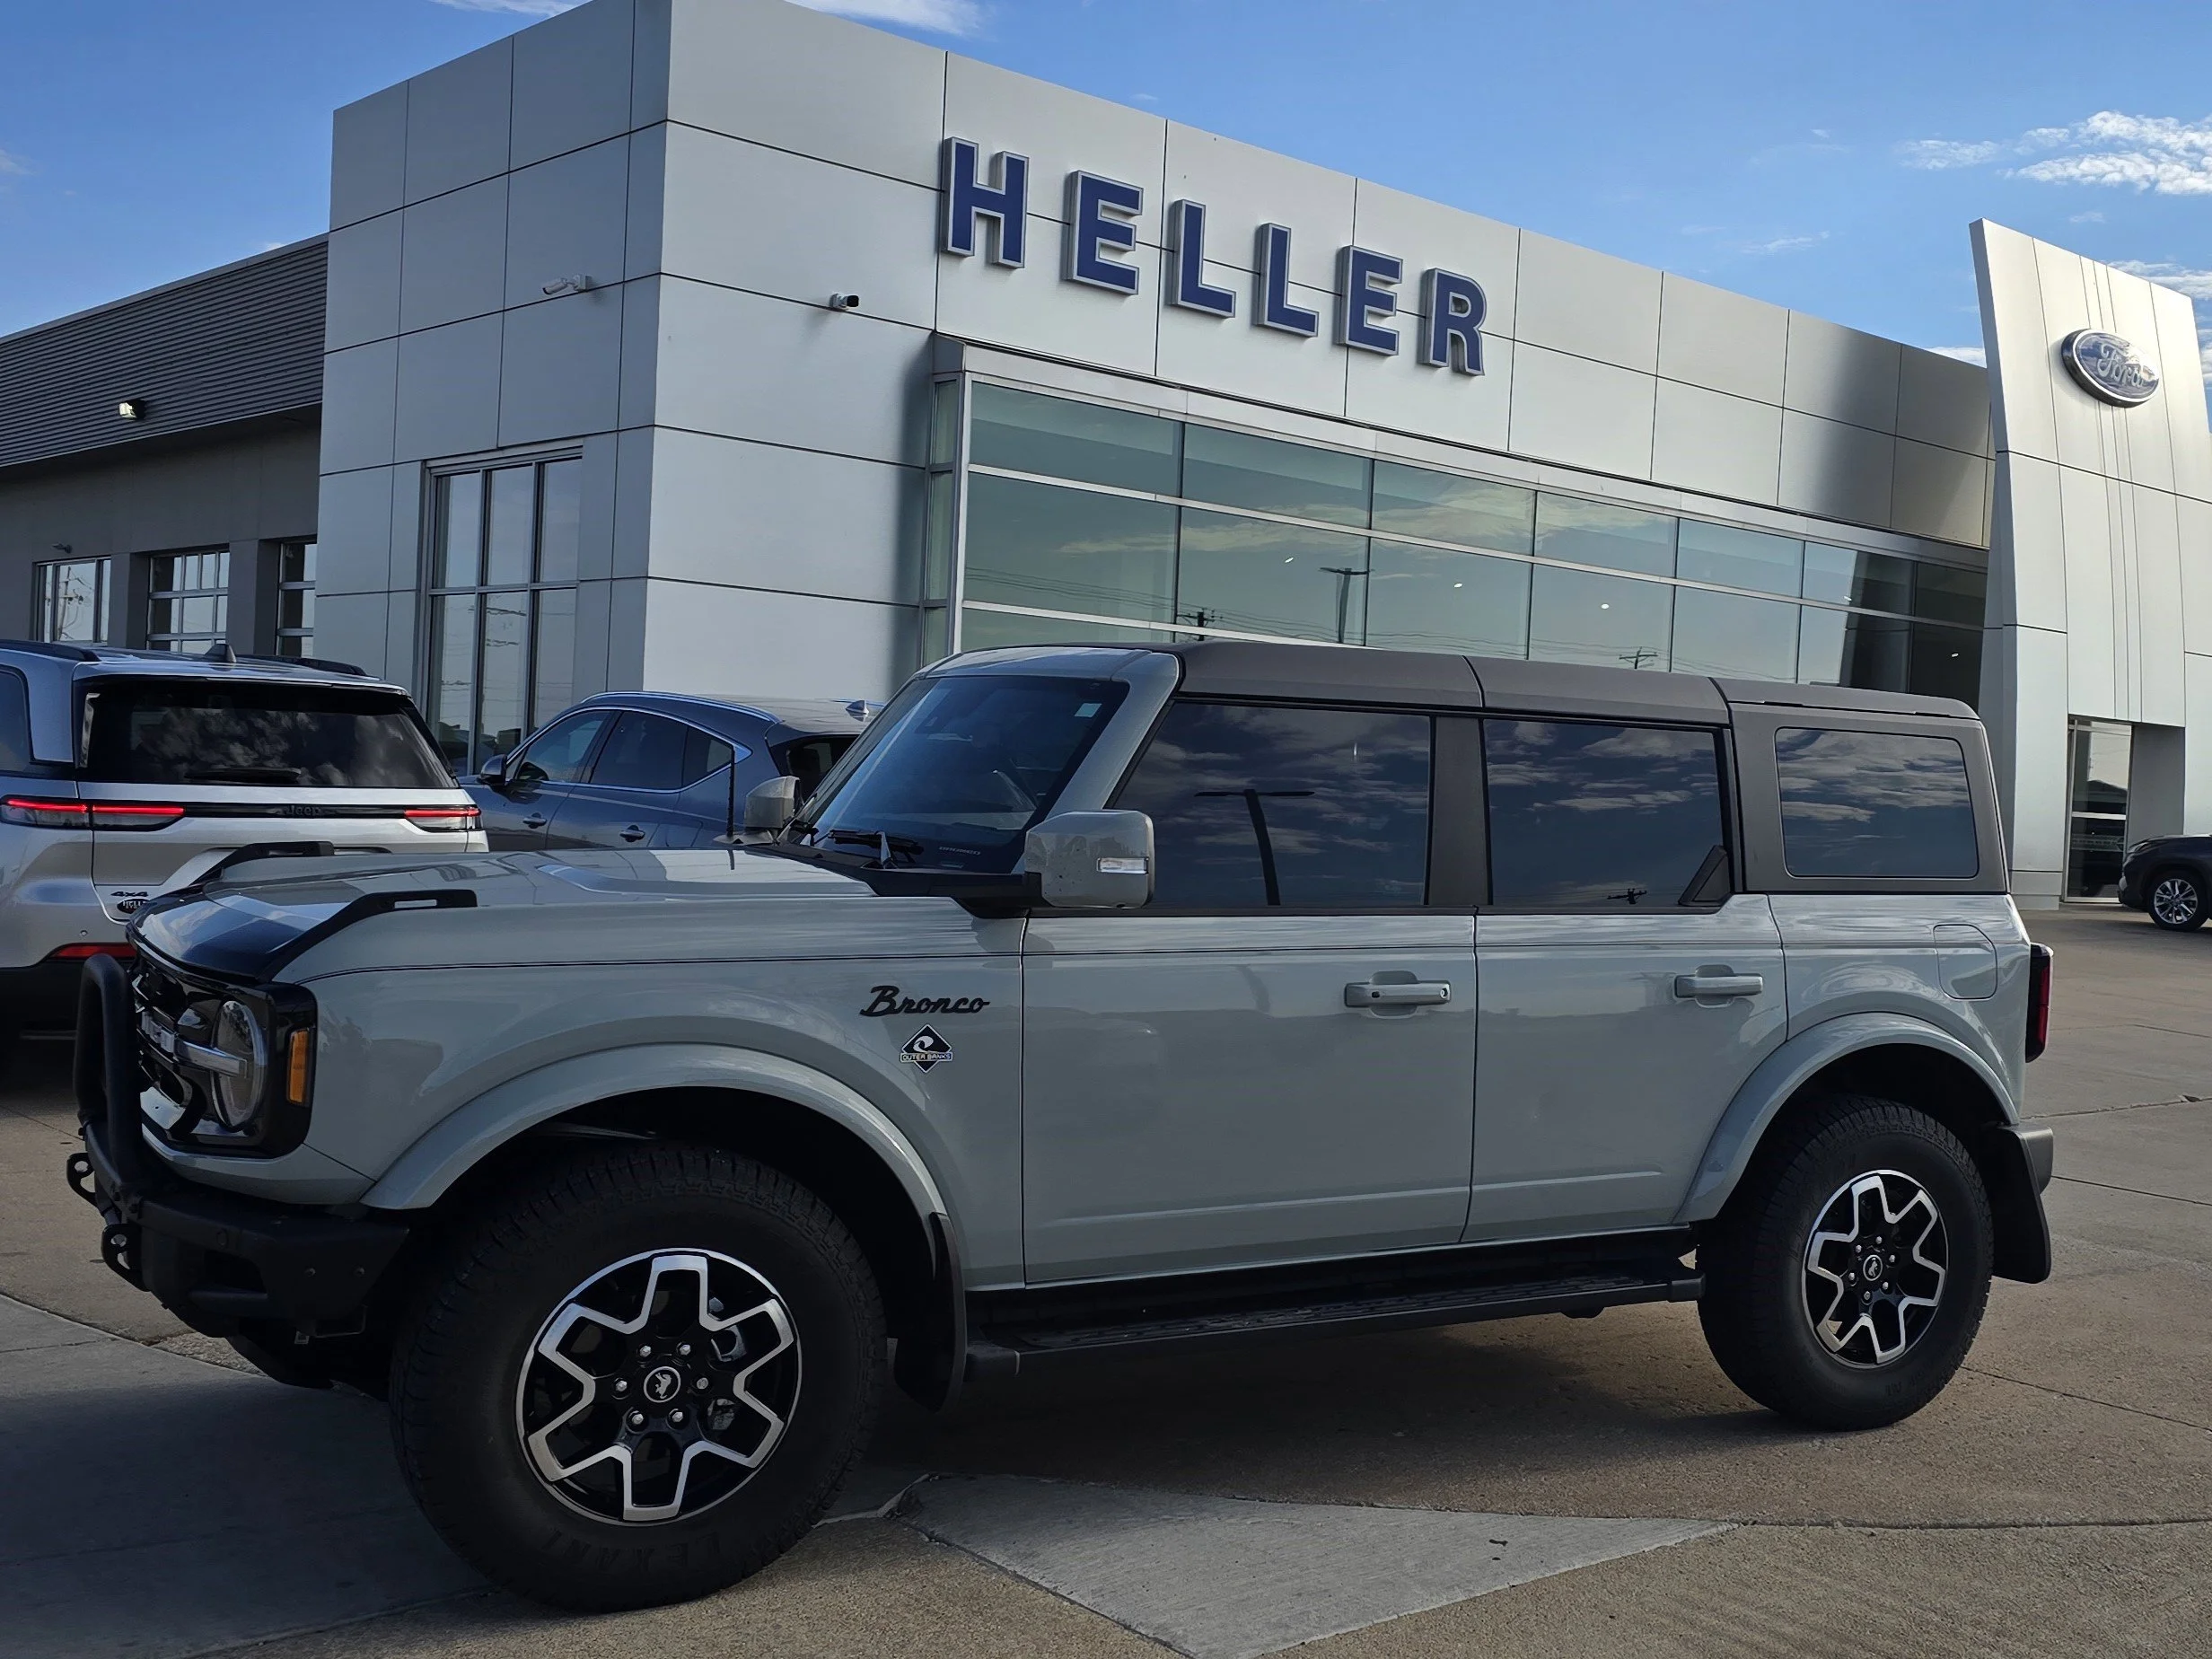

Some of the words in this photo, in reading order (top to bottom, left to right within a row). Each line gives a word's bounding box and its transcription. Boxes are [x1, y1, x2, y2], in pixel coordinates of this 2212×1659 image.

[943, 136, 1486, 376] HELLER
[2096, 343, 2145, 388] Ford
[287, 805, 321, 816] Jeep
[859, 985, 990, 1017] Bronco
